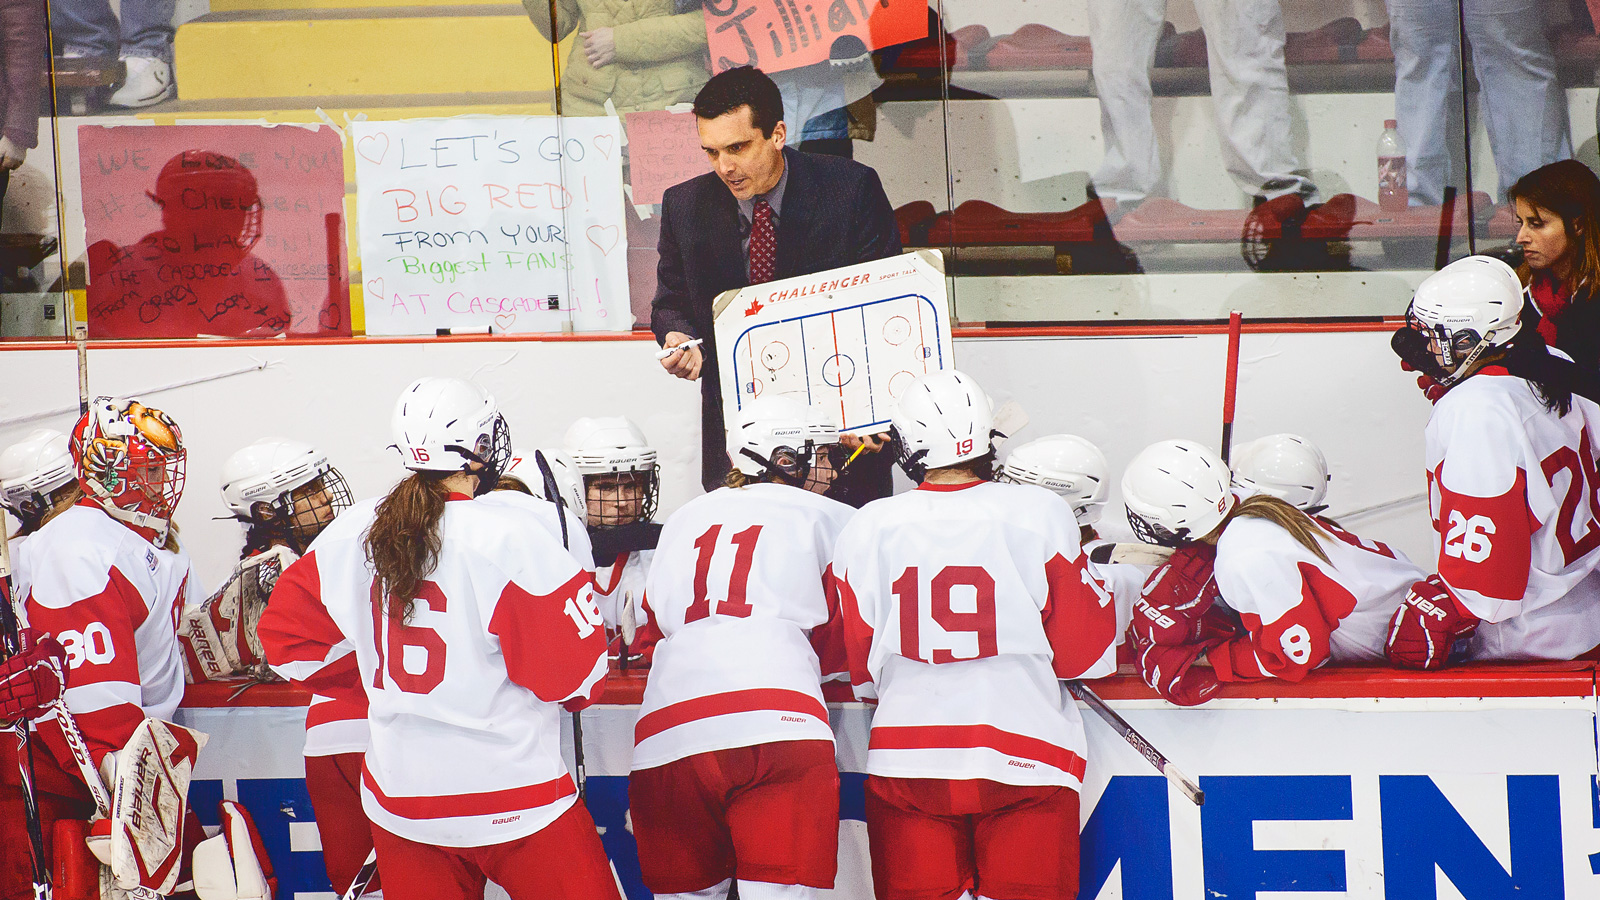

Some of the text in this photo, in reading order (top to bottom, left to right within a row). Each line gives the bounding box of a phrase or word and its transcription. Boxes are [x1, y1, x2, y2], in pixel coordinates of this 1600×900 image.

[98, 148, 151, 176] WE
[181, 151, 257, 170] LOVE
[400, 130, 585, 170] LET'S GO
[382, 185, 467, 223] BIG
[382, 224, 569, 252] FROM YOUR
[498, 250, 575, 271] FANS
[98, 266, 147, 286] THE
[768, 273, 871, 303] CHALLENGER
[879, 271, 899, 280] SPORT
[391, 293, 430, 315] AT
[409, 447, 431, 462] 16
[609, 457, 638, 465] BAUER
[956, 438, 973, 456] 19
[508, 457, 523, 472] 7
[244, 485, 266, 497] BAUER
[1044, 480, 1072, 490] BAUER
[1444, 508, 1496, 564] 26
[684, 523, 764, 624] 11
[892, 565, 998, 664] 19
[56, 621, 116, 670] 30
[189, 618, 221, 673] BAUER
[370, 576, 447, 694] 16
[1279, 623, 1312, 665] 8
[781, 715, 807, 724] BAUER
[1008, 758, 1036, 771] BAUER
[132, 746, 152, 831] BAUER
[492, 815, 521, 825] BAUER
